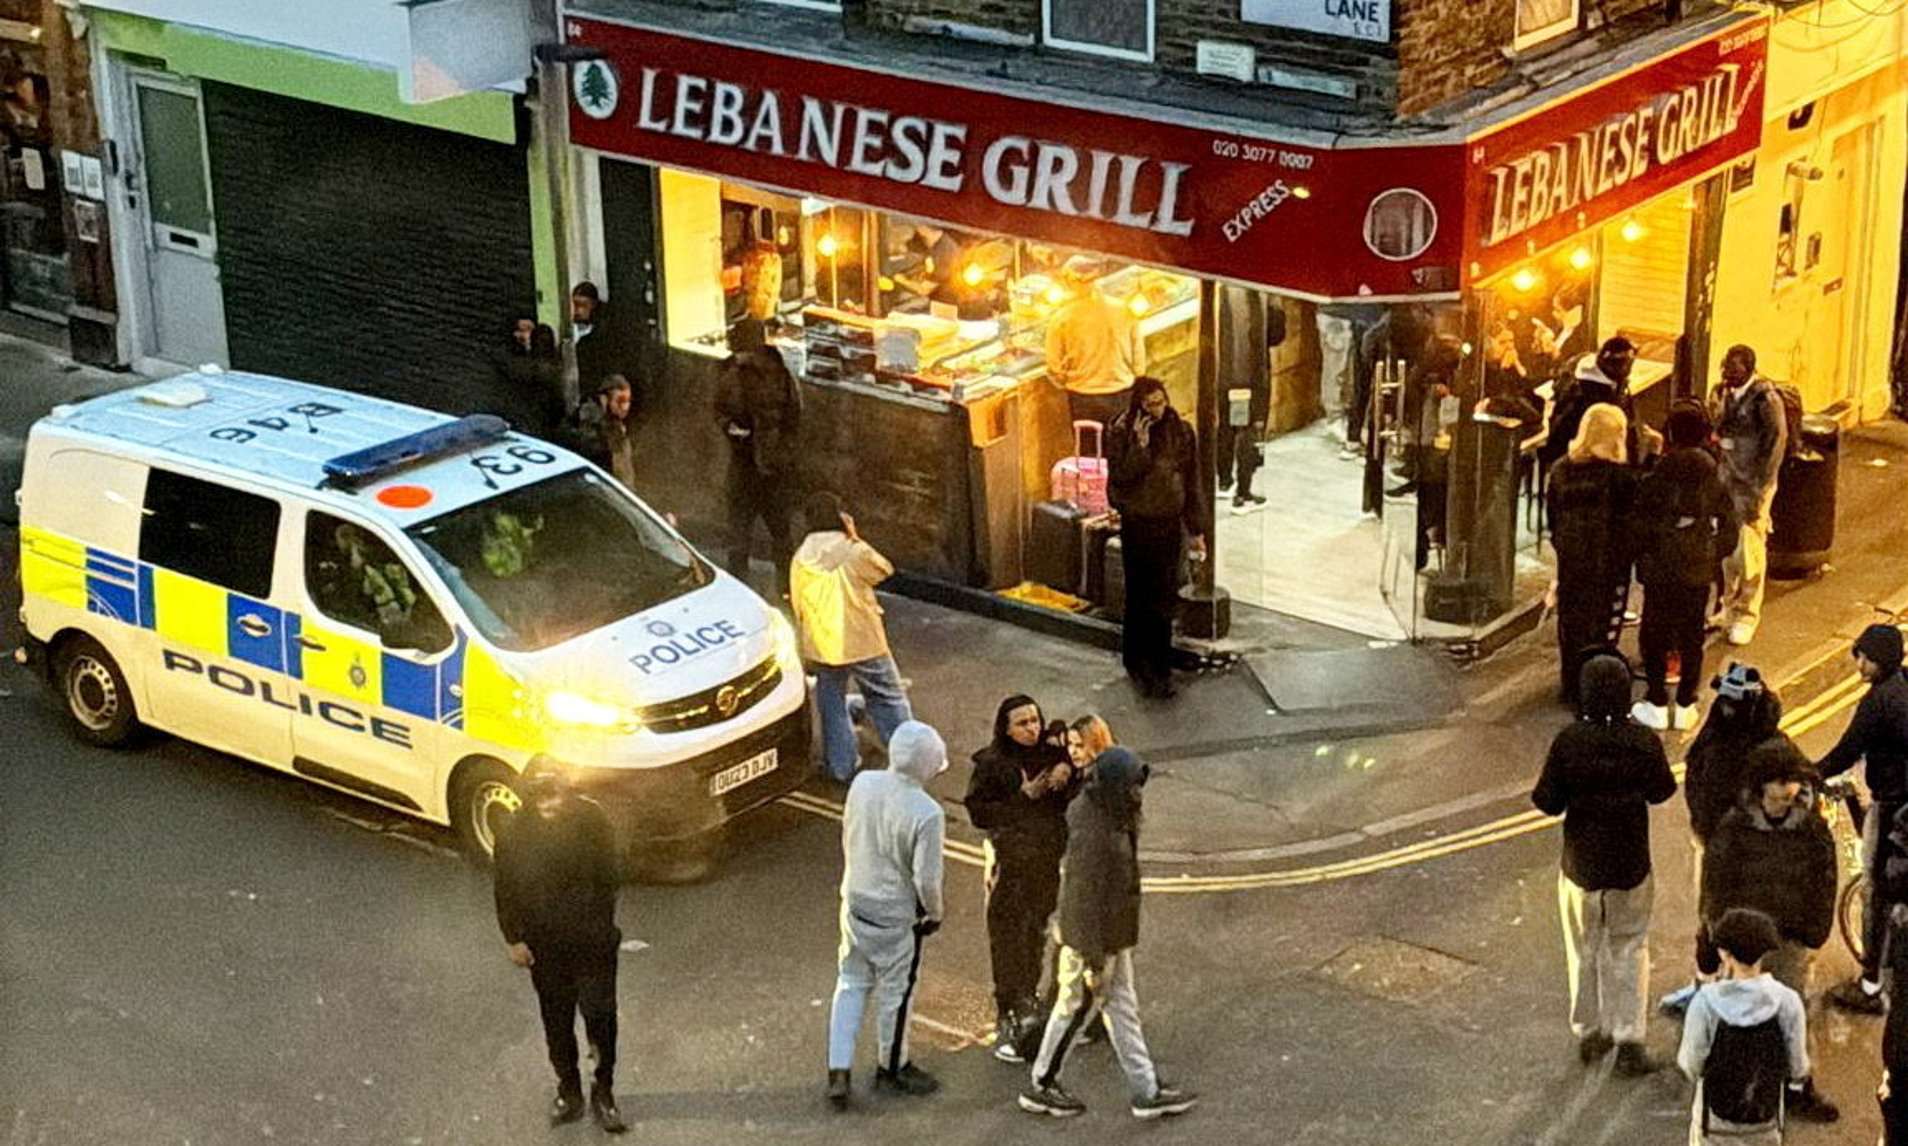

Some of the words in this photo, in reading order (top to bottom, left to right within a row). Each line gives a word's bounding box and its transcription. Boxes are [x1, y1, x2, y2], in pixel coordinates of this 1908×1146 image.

[1325, 0, 1379, 22] LANE
[637, 67, 968, 192] LEBANESE
[982, 135, 1195, 237] GRILL
[1213, 139, 1238, 159] 020
[1242, 144, 1275, 164] 3077
[1487, 107, 1653, 246] LEBANESE
[1657, 63, 1740, 165] GRILL
[1222, 179, 1290, 242] EXPRESS
[629, 620, 745, 674] POLICE
[163, 649, 413, 750] POLICE
